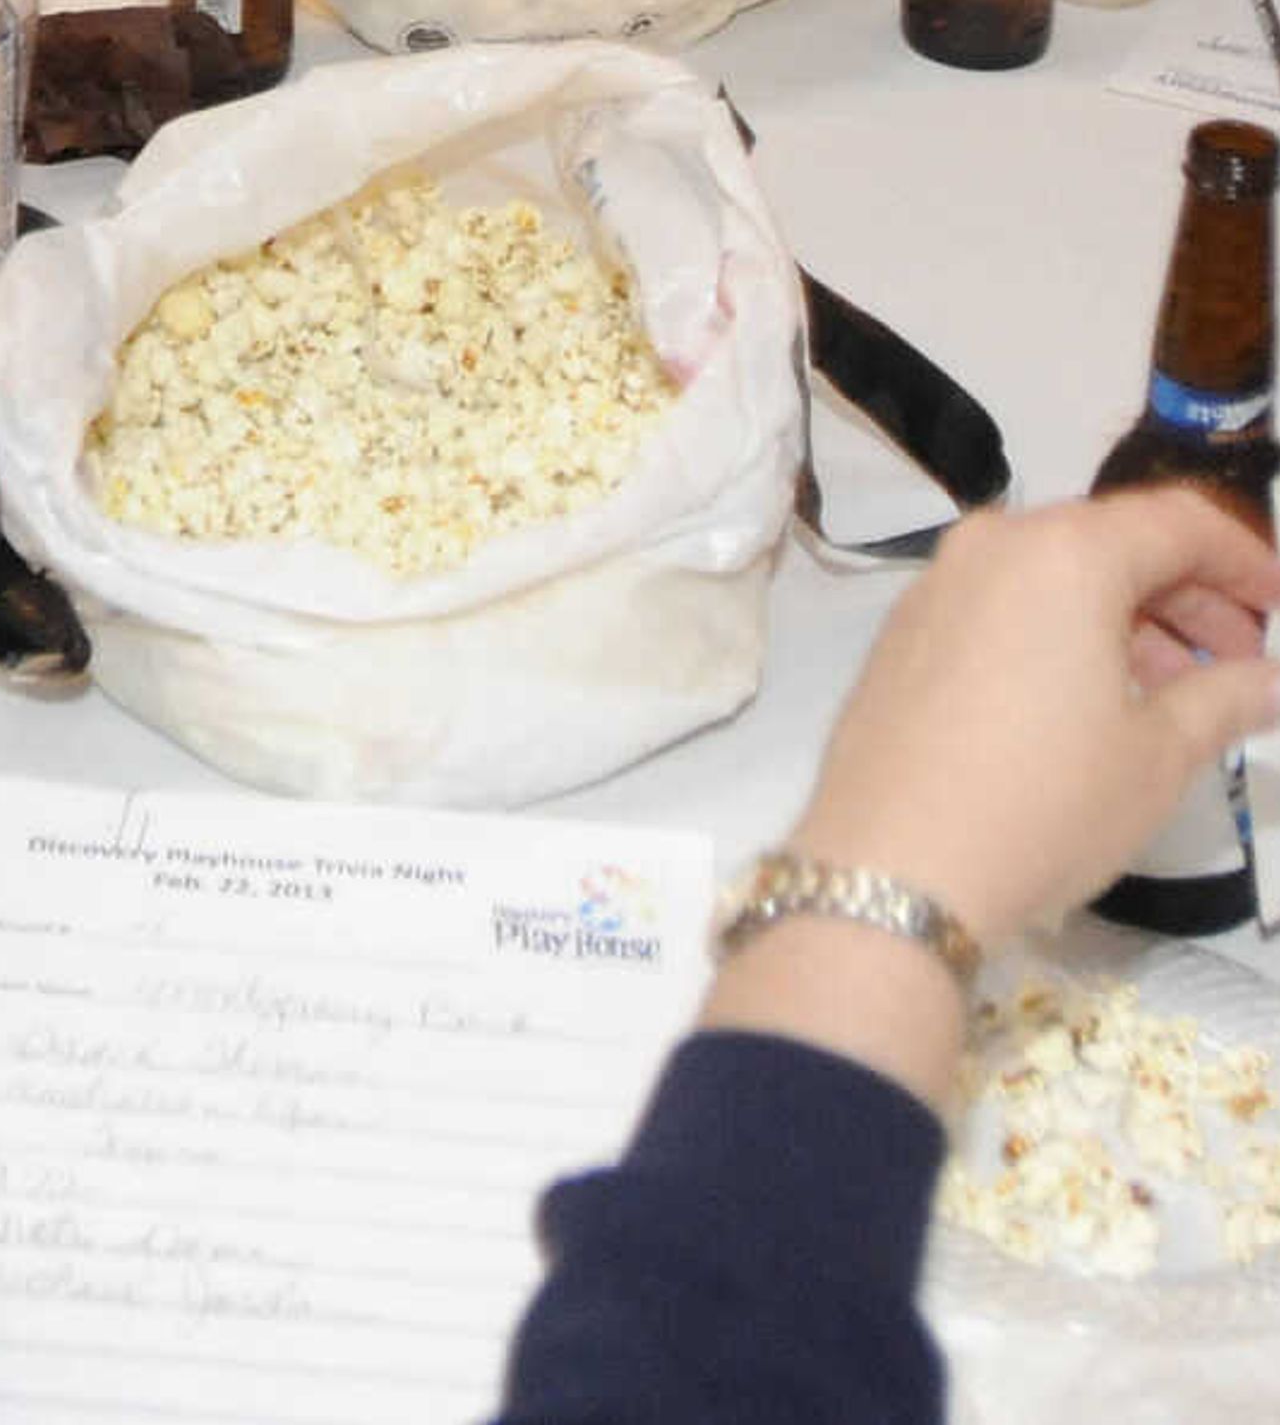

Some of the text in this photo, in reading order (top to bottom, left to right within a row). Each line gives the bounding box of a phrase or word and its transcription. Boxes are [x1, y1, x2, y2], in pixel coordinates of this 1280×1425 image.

[26, 834, 468, 886] Discovery Playhouse Trivia Night
[268, 880, 336, 902] 2013
